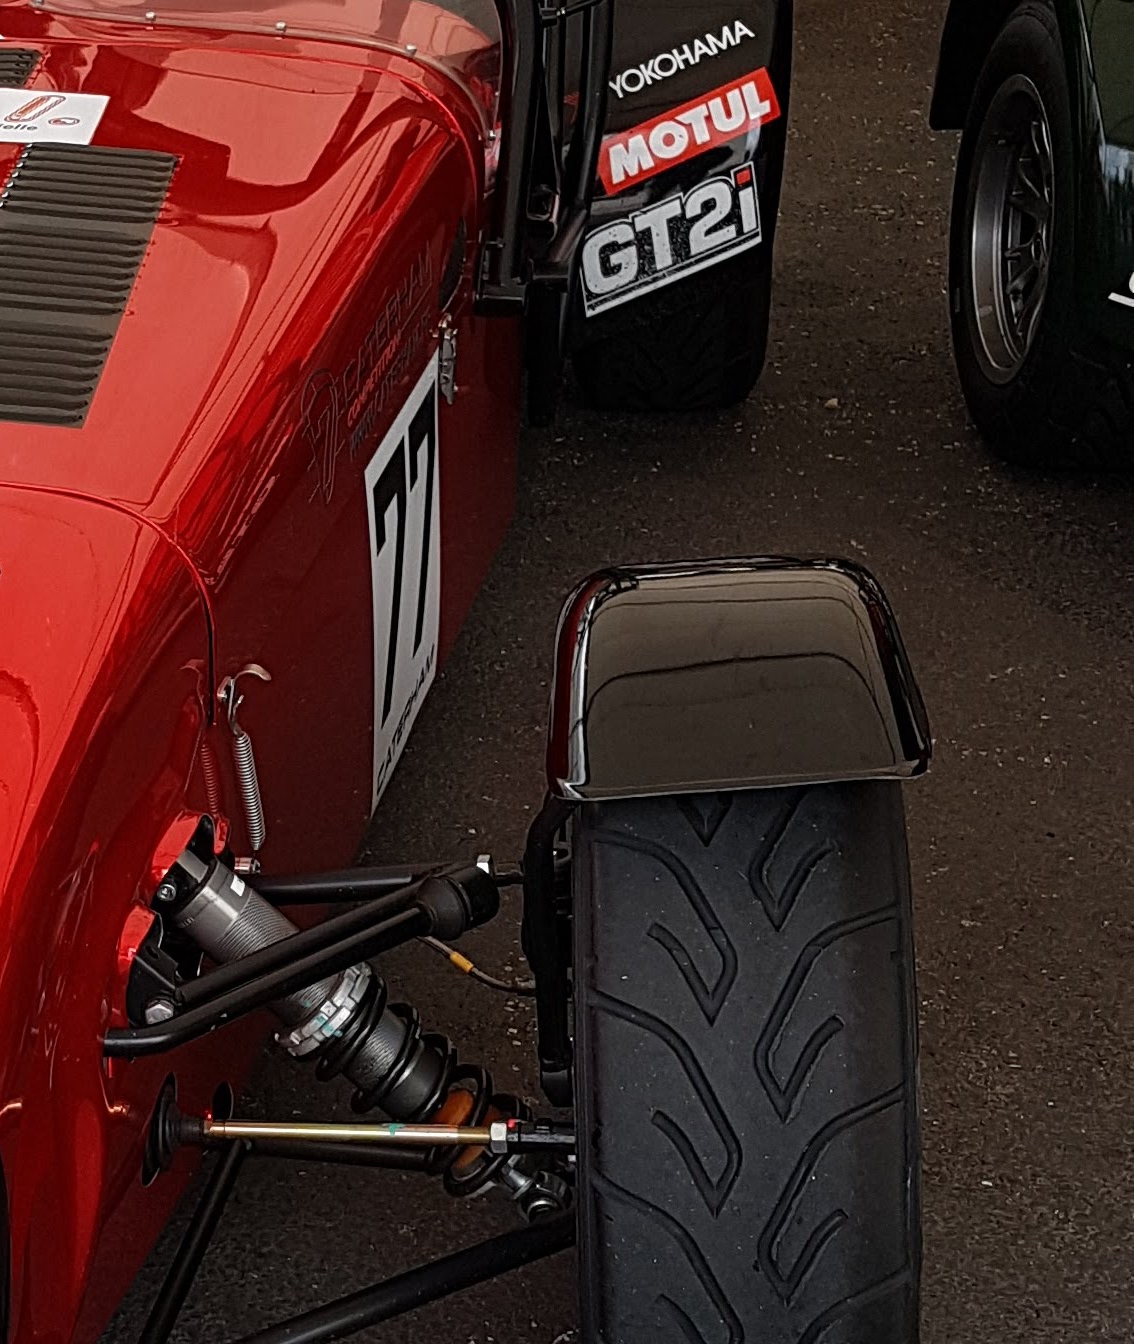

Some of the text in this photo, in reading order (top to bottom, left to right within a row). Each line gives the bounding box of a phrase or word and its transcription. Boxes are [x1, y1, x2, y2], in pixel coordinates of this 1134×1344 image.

[608, 19, 756, 99] YOKOHAMA
[608, 80, 771, 185] MOTUL
[582, 168, 758, 295] GT2i
[343, 242, 432, 405] CATERHAM
[373, 379, 435, 731] 77
[376, 643, 435, 796] CATERHAM
